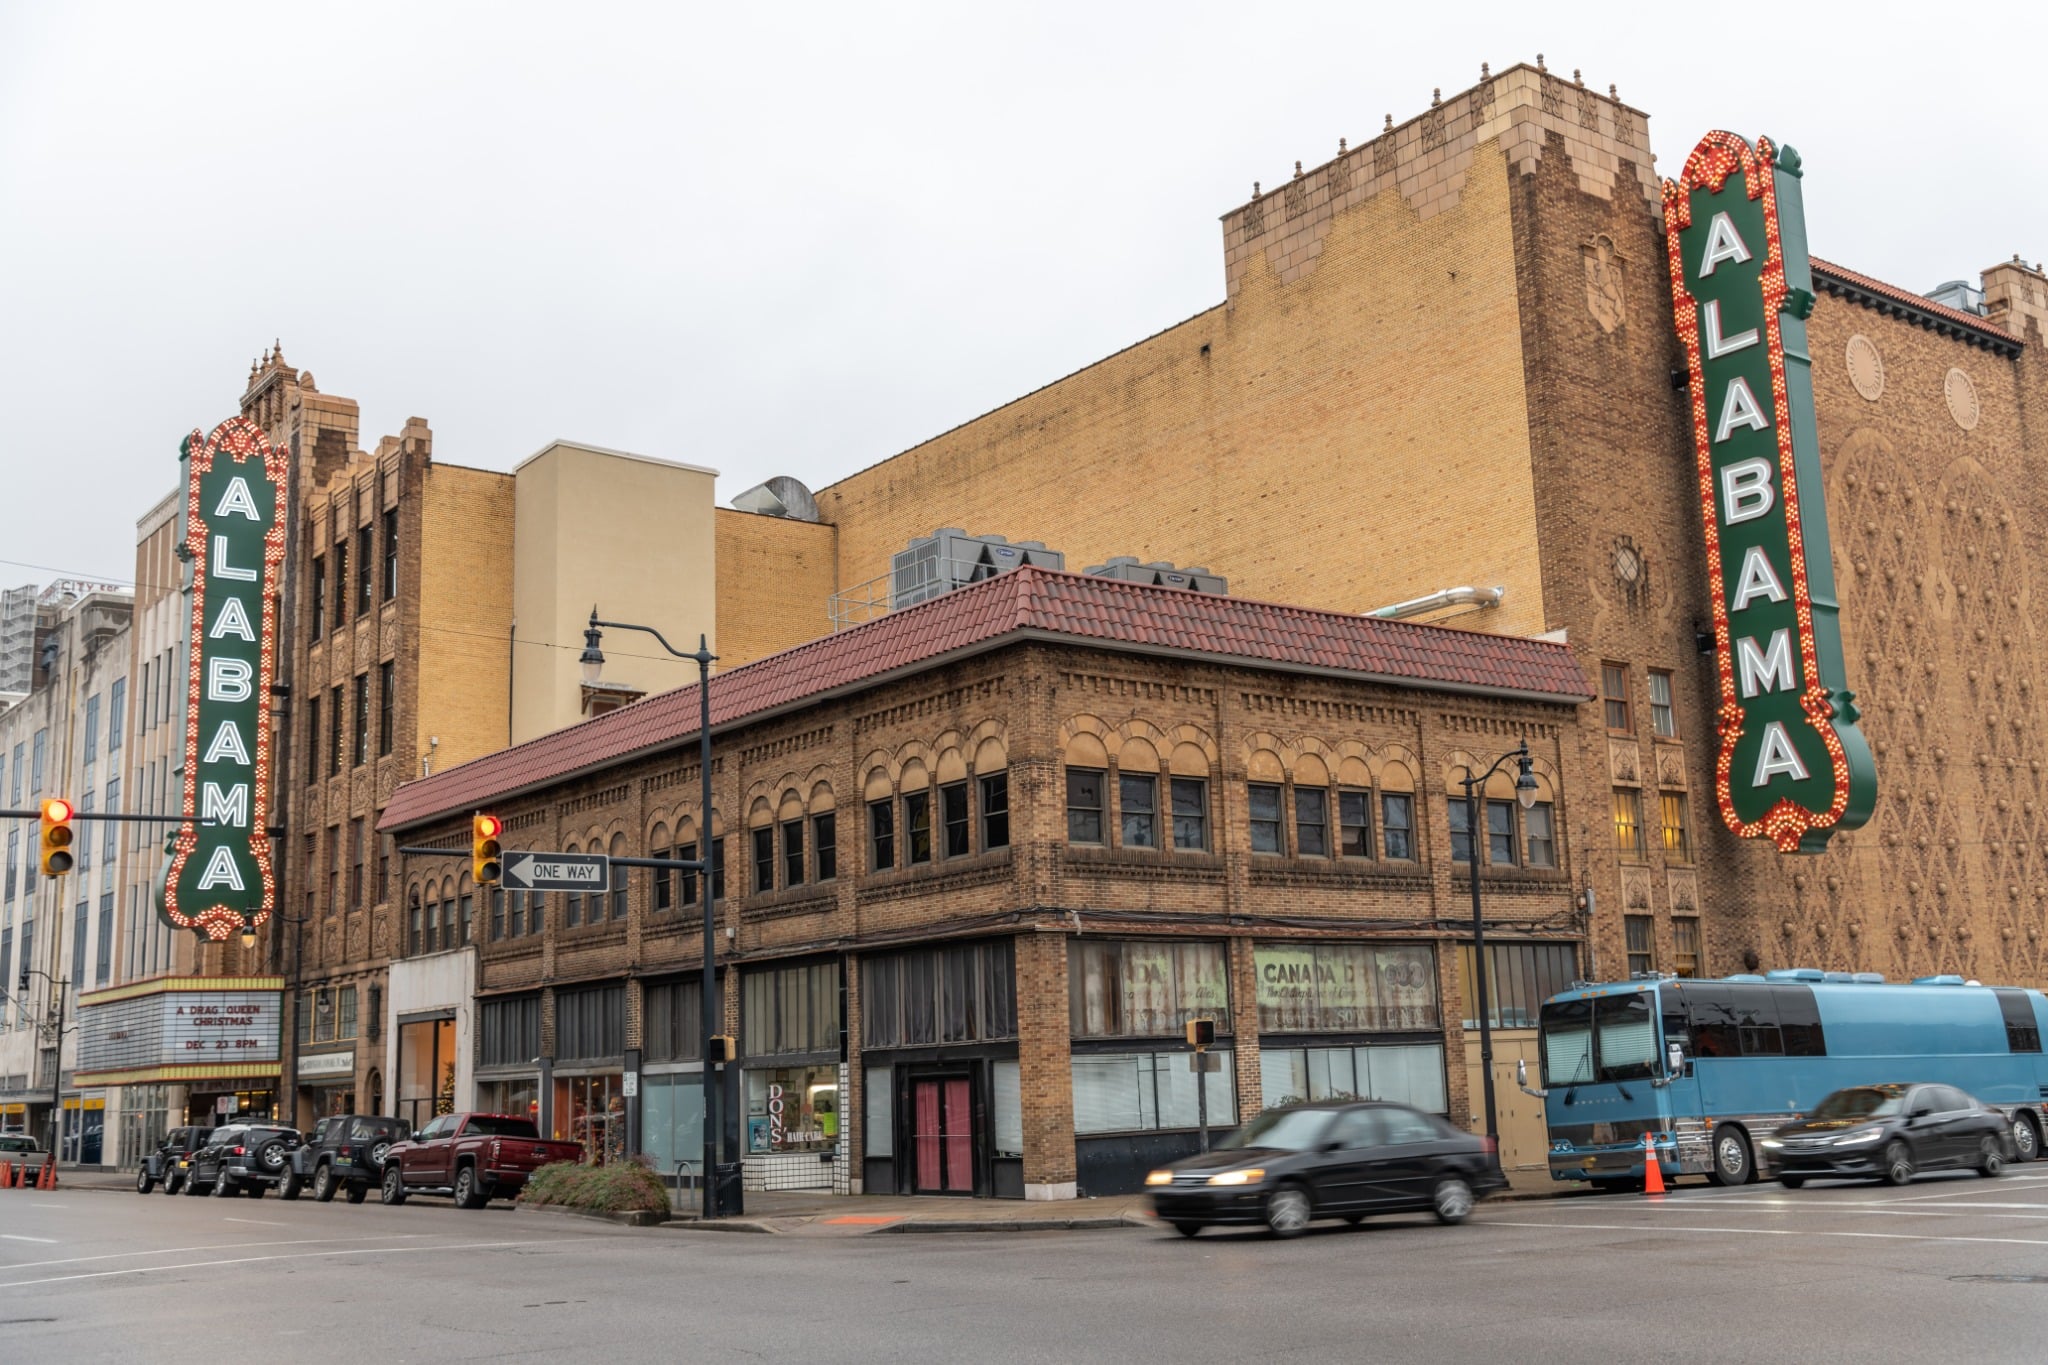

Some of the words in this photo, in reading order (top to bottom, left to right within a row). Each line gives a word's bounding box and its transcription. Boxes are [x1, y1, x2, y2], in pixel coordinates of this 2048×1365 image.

[1698, 210, 1810, 788] ALABAMA
[197, 476, 261, 891] ALABAMA
[534, 864, 560, 878] ONE
[567, 866, 594, 879] WAY
[1263, 963, 1337, 984] CANADA
[176, 1006, 184, 1015] A
[190, 1006, 218, 1014] DRAG
[226, 1005, 260, 1014] QUEEN
[193, 1017, 253, 1026] CHRISTMAS
[186, 1041, 205, 1049] DEC
[216, 1040, 228, 1049] 23
[236, 1040, 257, 1048] 8PM
[787, 1131, 804, 1142] HAIR
